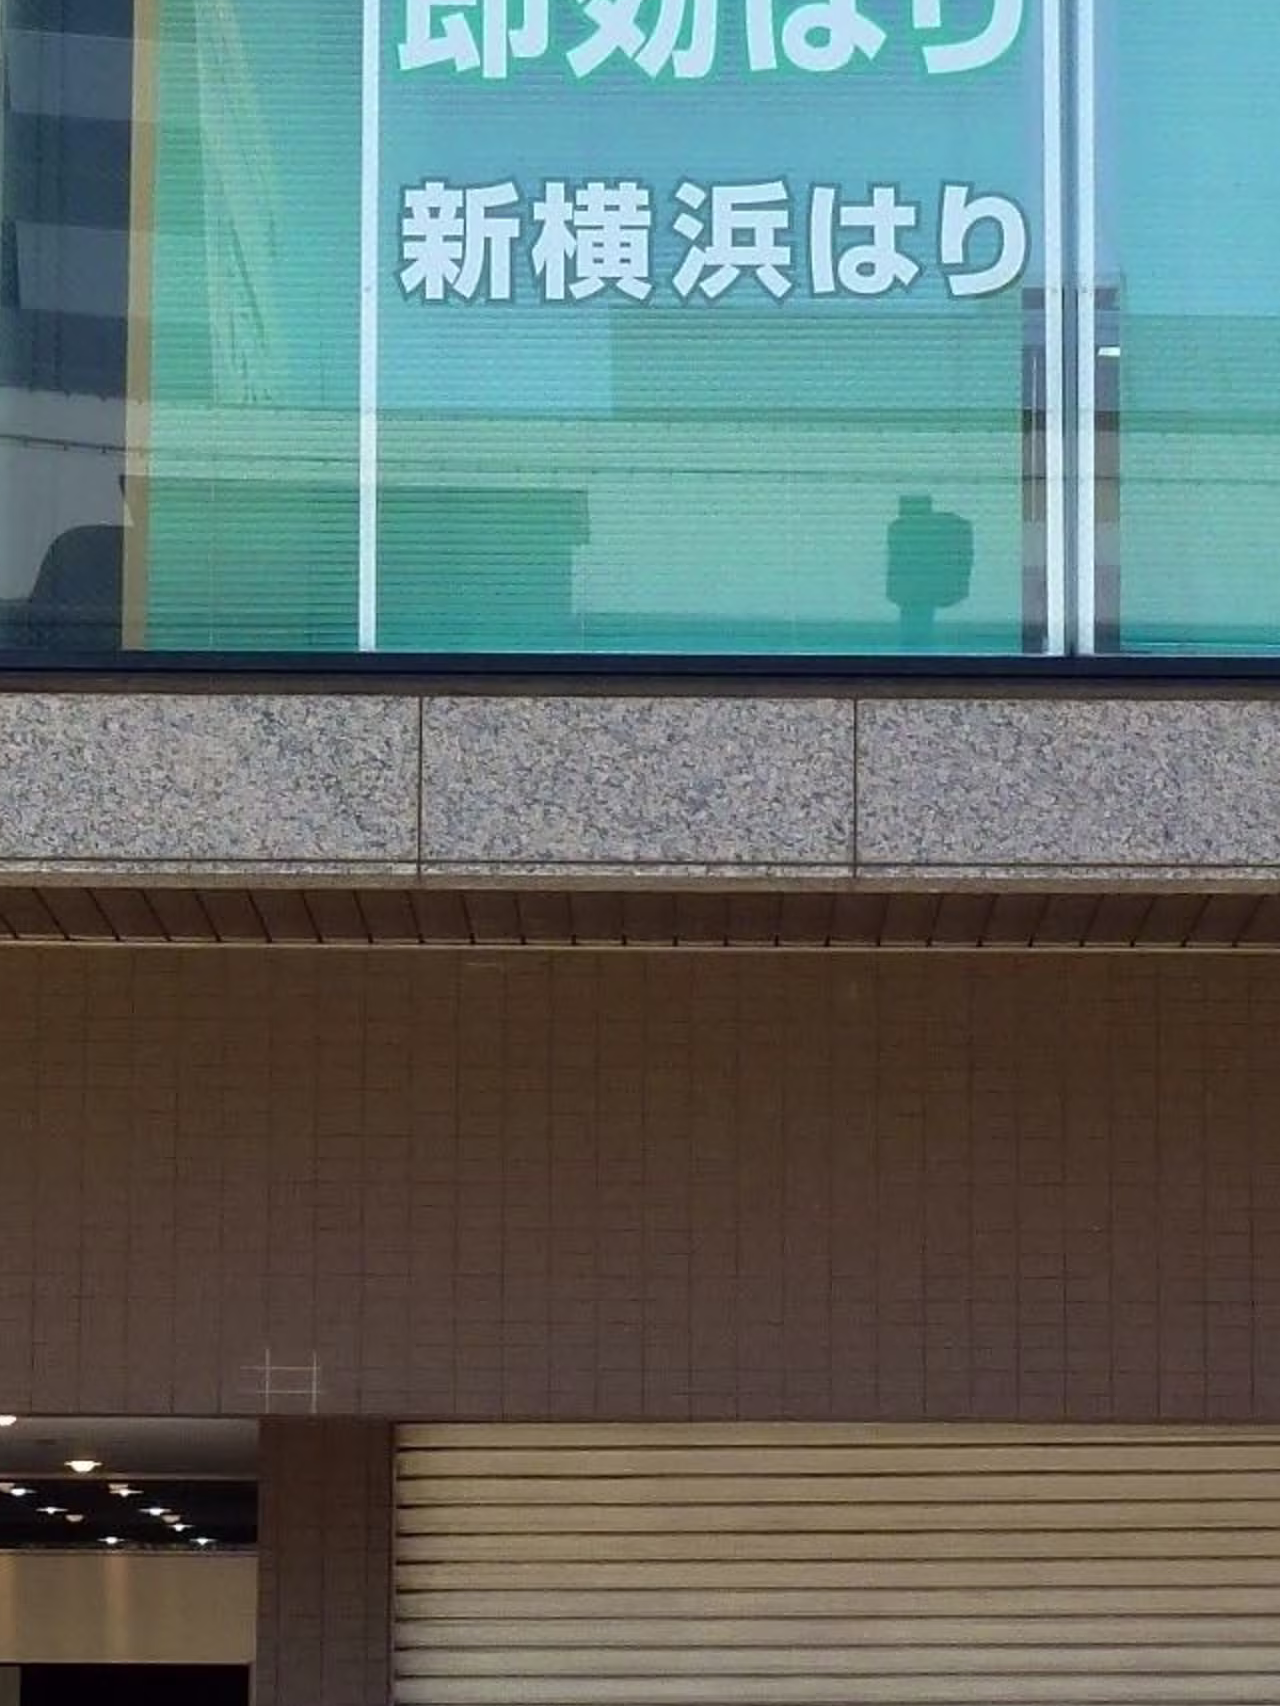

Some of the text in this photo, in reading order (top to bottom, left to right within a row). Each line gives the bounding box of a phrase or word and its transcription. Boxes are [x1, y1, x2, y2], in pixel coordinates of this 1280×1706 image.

[397, 179, 1029, 302] 新横浜はり
